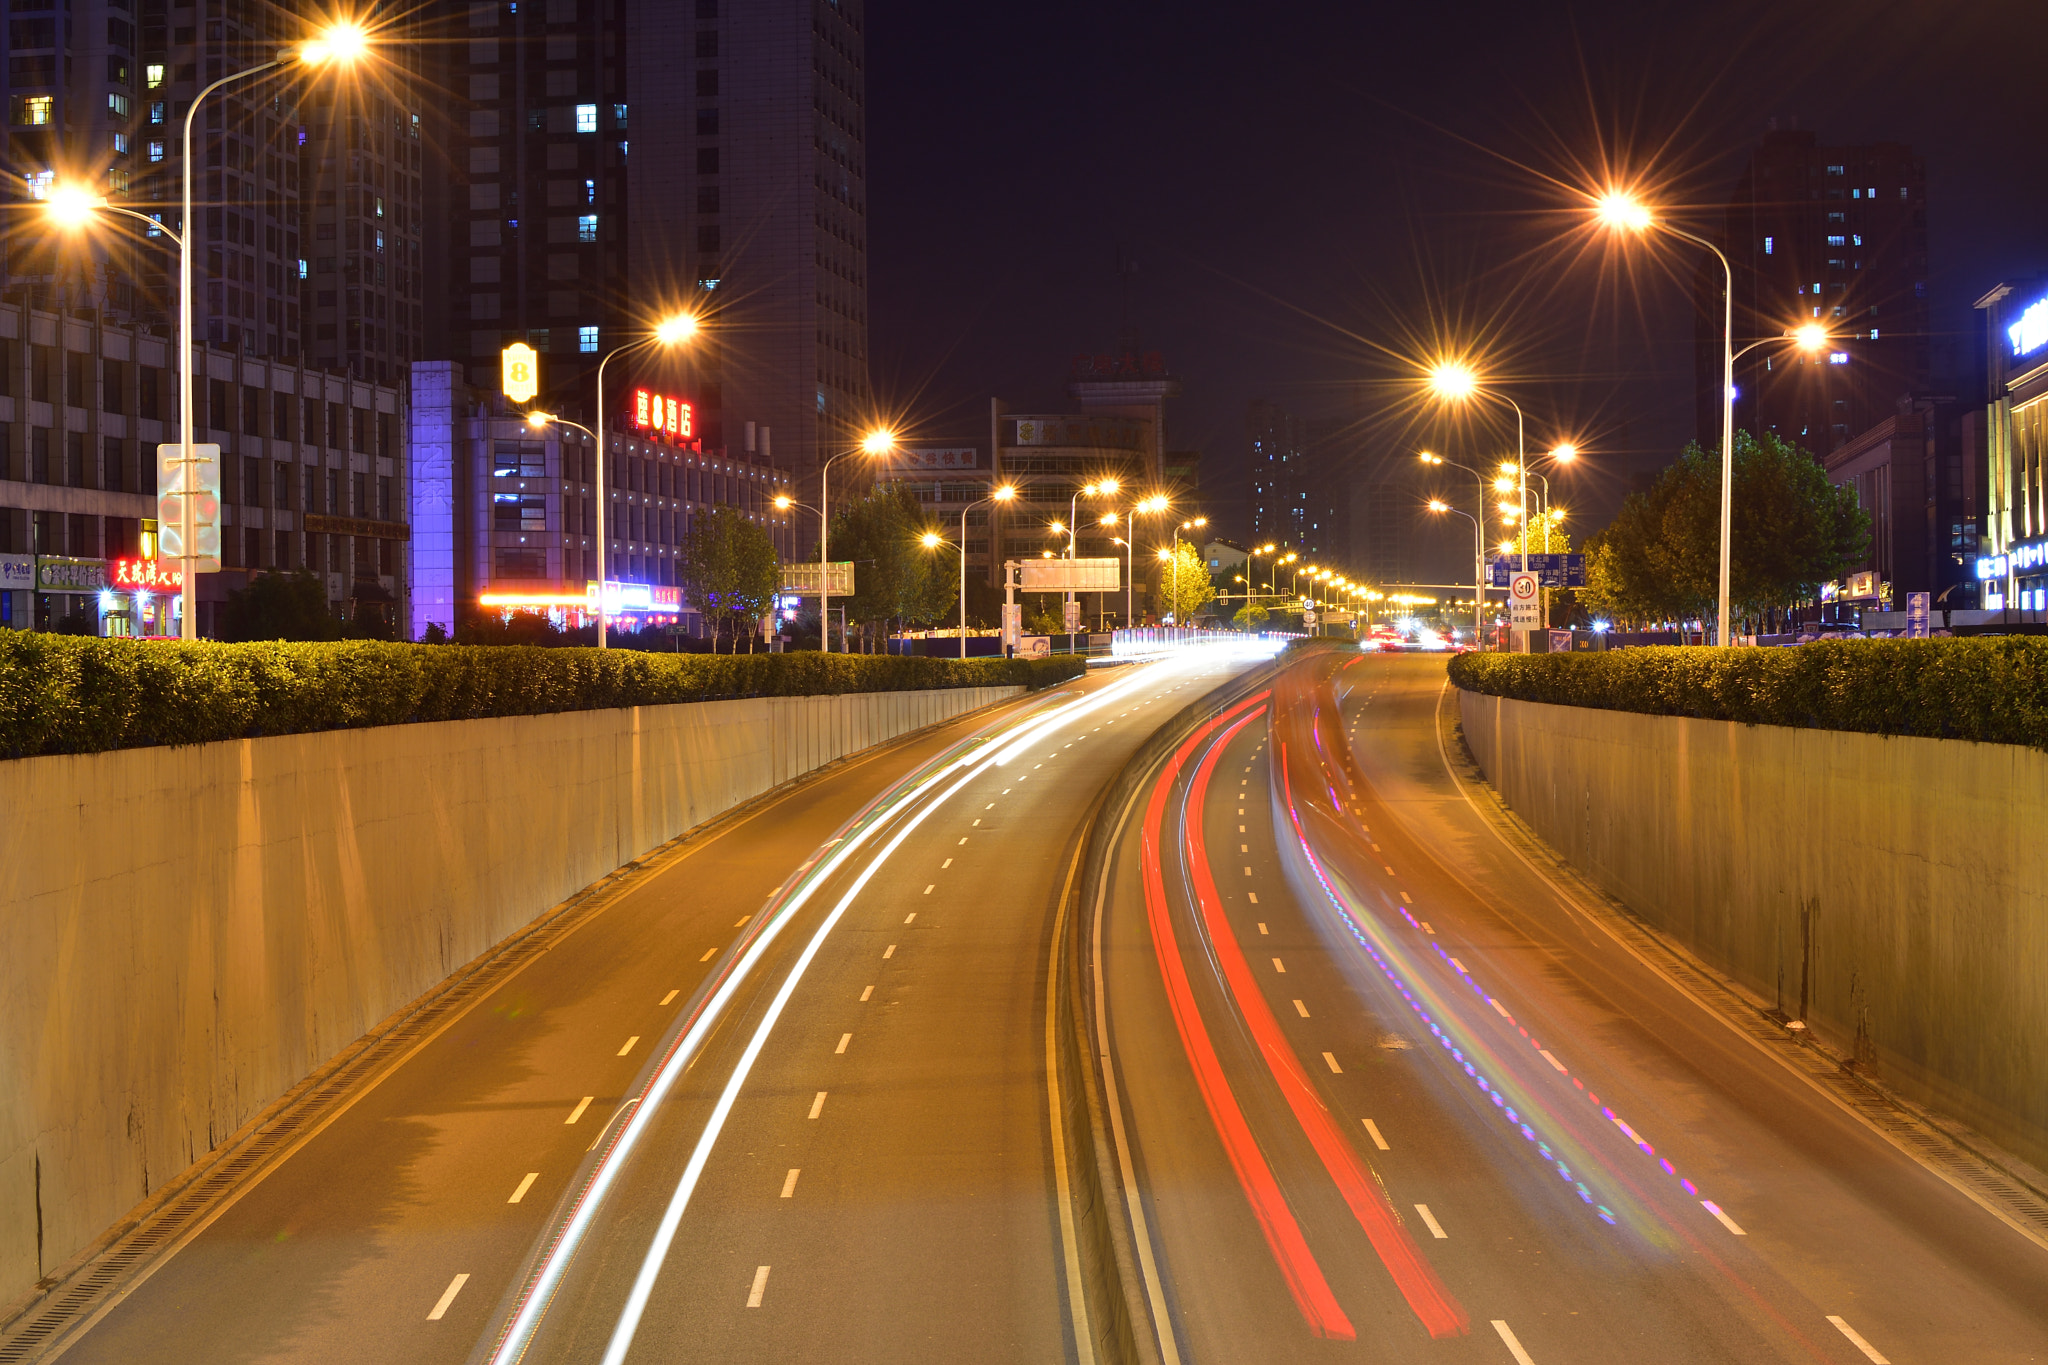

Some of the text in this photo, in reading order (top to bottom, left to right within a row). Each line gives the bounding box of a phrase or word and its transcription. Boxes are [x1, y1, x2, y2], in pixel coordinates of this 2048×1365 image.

[507, 353, 533, 362] SUPER
[510, 362, 530, 382] 8
[1518, 581, 1531, 594] 30
[1513, 615, 1538, 623] 减速慢行
